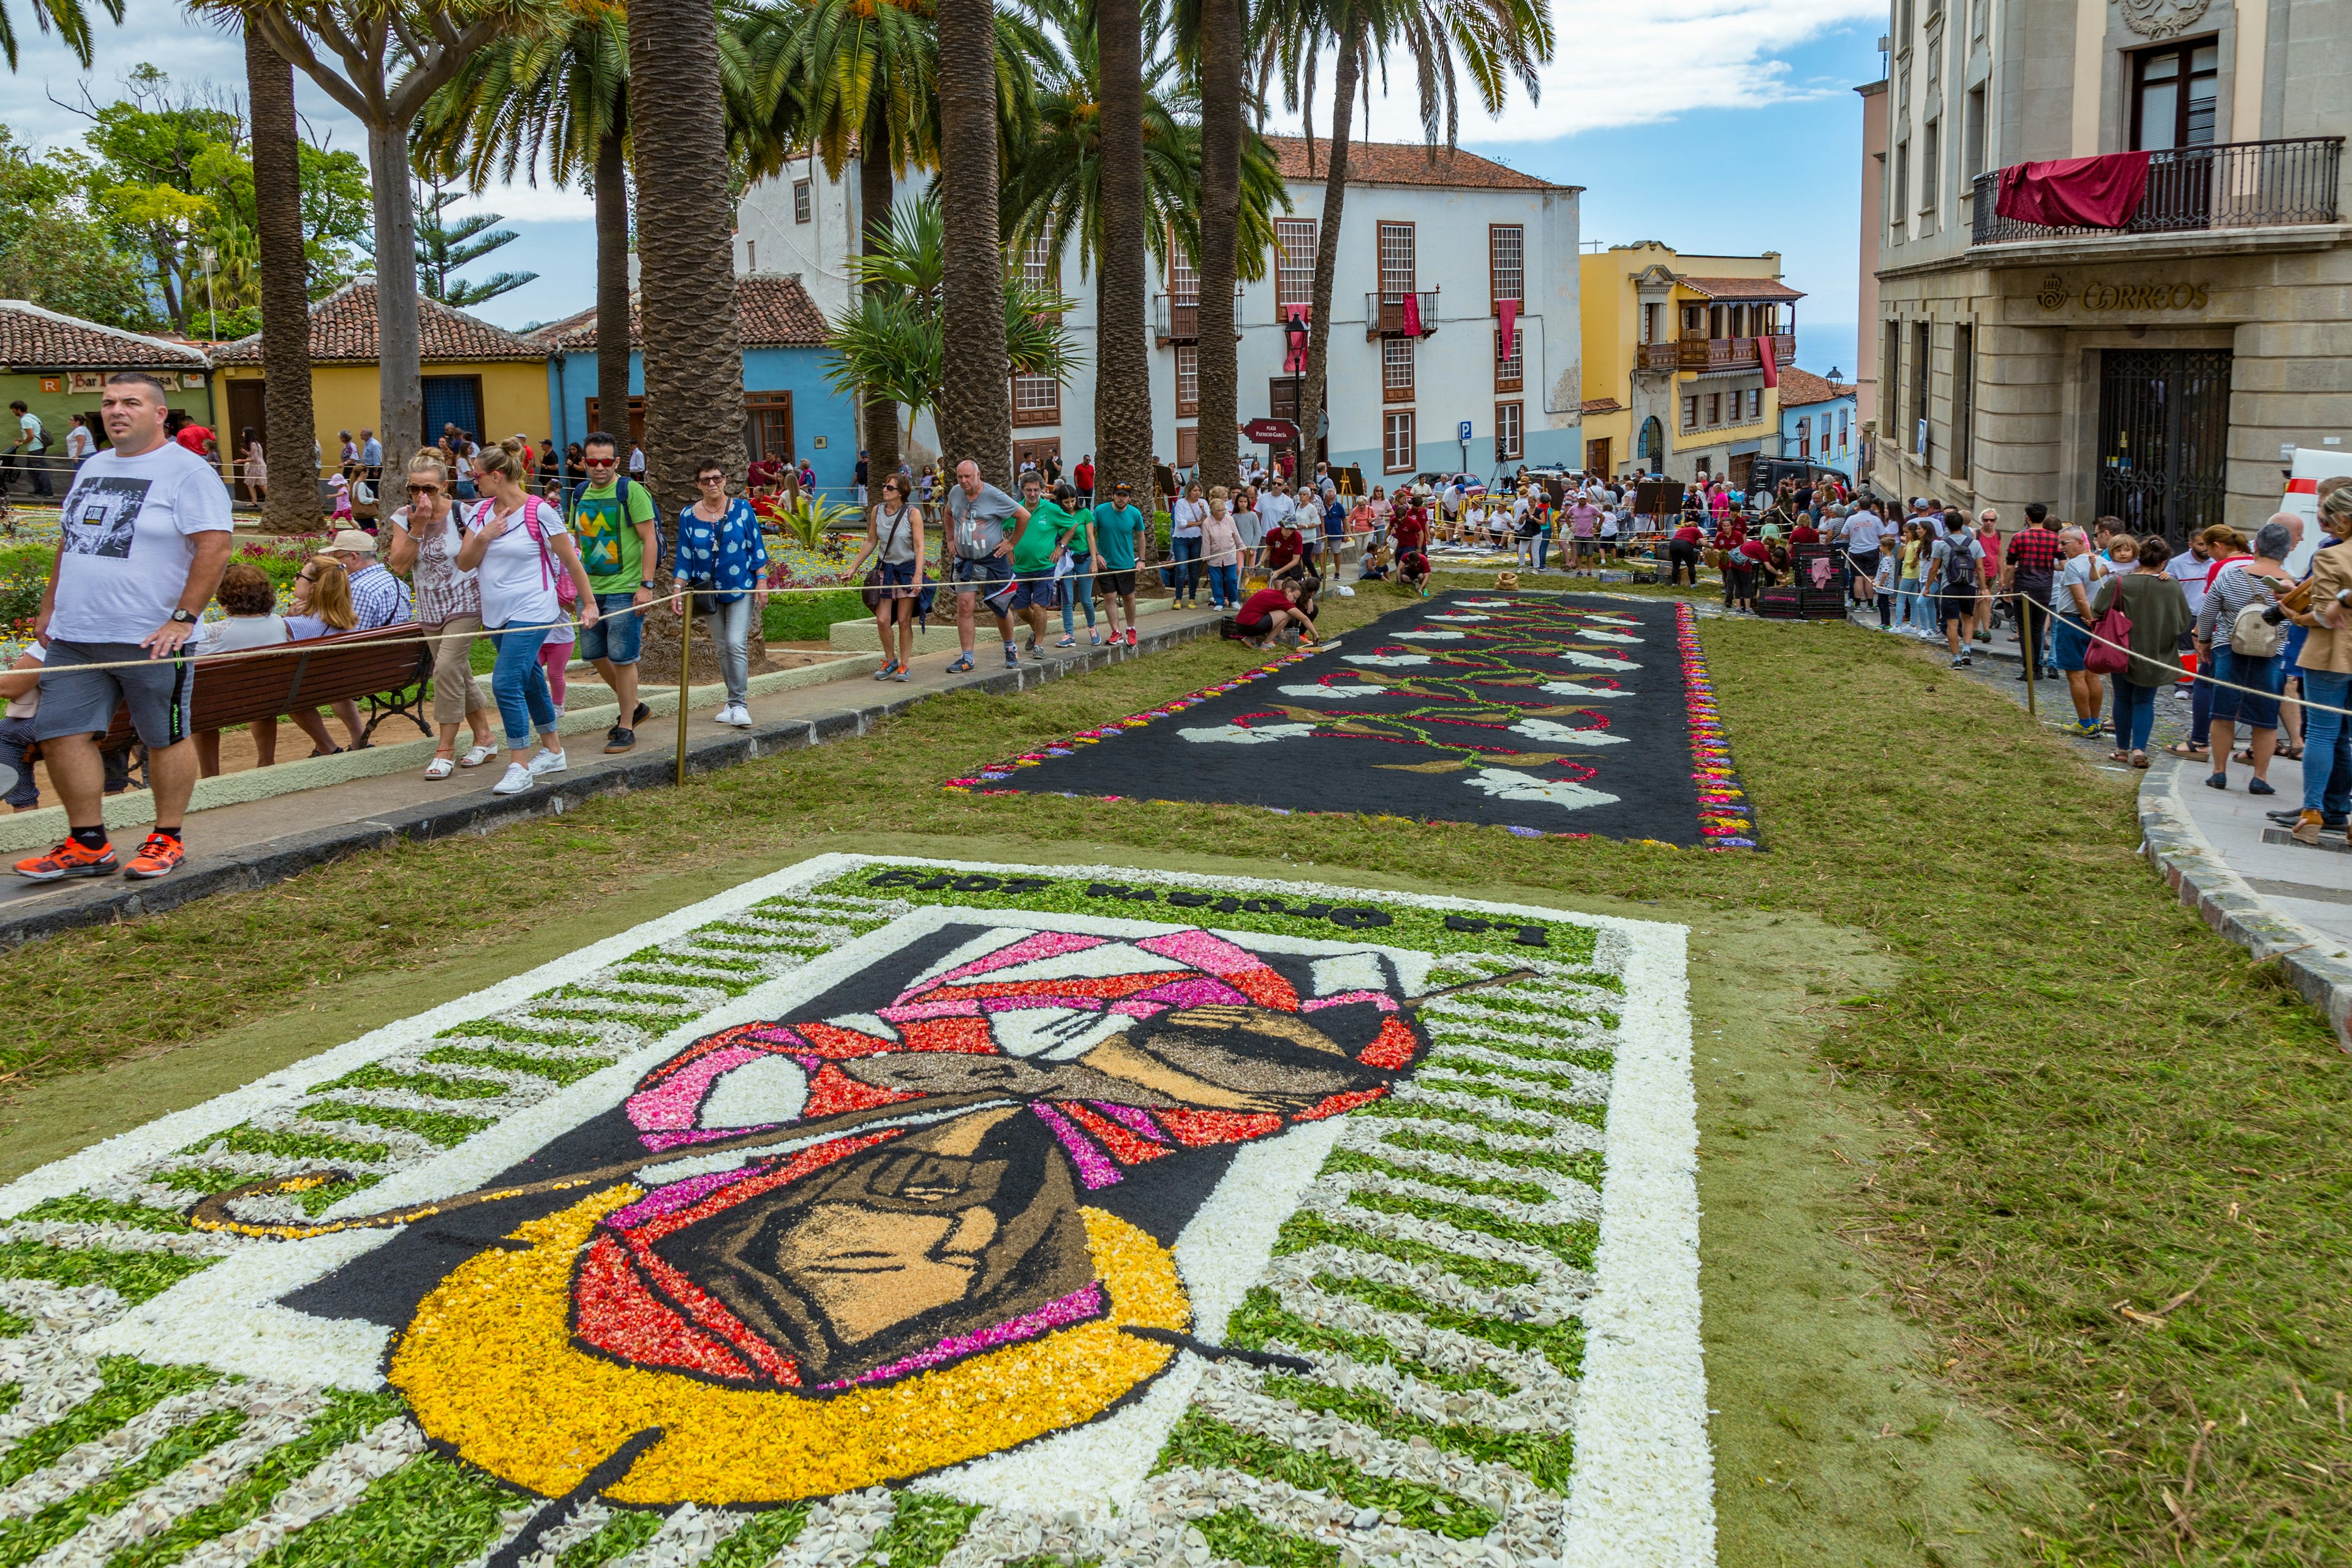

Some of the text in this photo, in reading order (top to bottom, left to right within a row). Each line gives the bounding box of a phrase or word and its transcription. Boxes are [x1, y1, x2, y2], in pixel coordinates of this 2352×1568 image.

[2079, 281, 2210, 311] CORREOS
[45, 381, 56, 391] R
[75, 374, 97, 387] Bar
[1462, 423, 1469, 438] P
[85, 507, 104, 520] SEOUL
[865, 869, 1551, 947] La Orotava 2019
